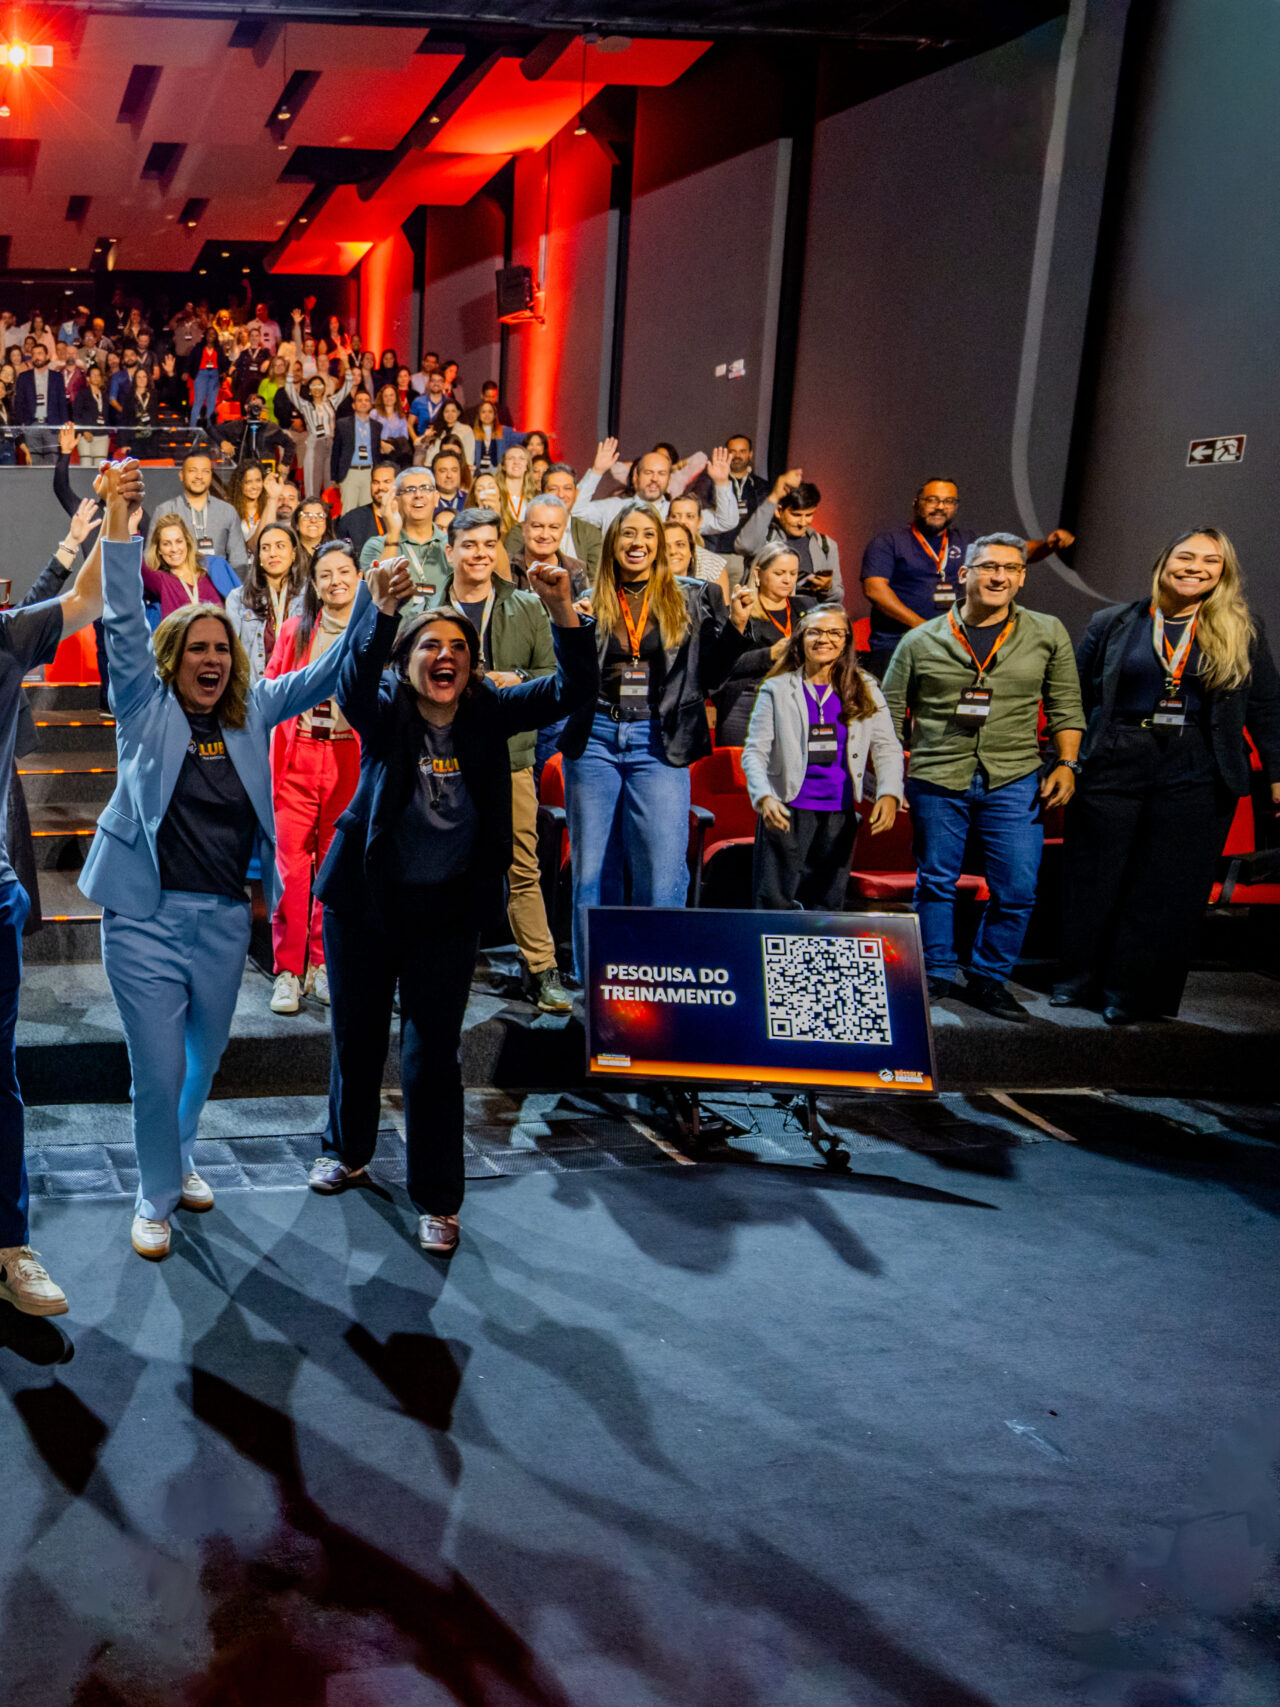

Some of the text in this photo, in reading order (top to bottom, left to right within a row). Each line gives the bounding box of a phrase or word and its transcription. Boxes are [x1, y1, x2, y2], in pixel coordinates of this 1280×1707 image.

[198, 741, 225, 756] LUB
[606, 964, 729, 984] PESQUISA DO
[600, 984, 736, 1006] TREINAMENTO
